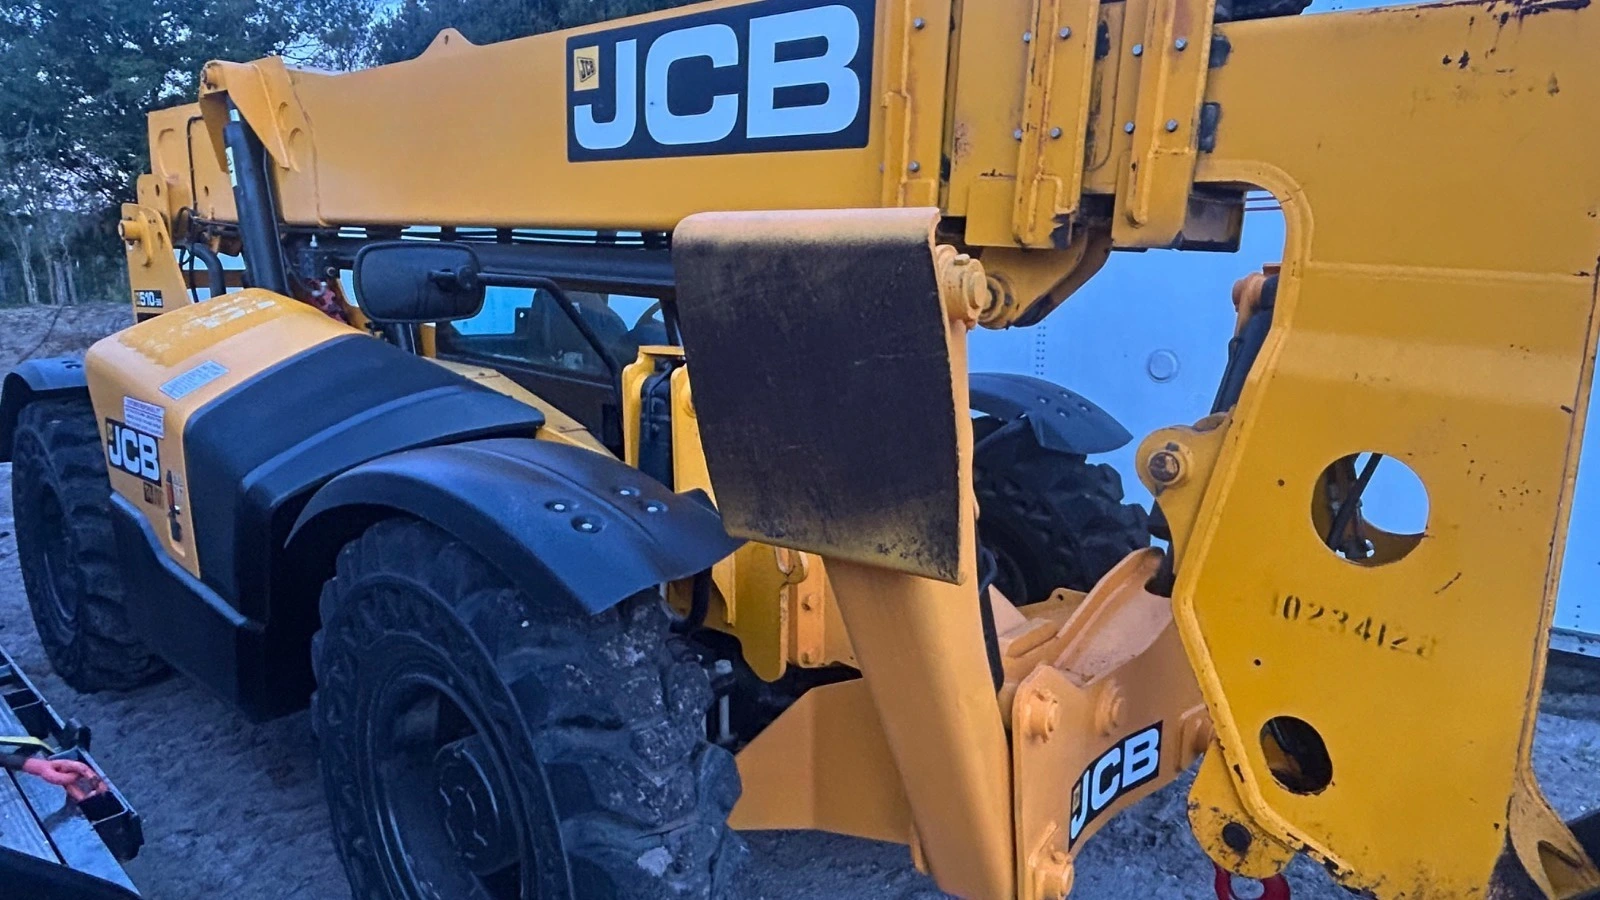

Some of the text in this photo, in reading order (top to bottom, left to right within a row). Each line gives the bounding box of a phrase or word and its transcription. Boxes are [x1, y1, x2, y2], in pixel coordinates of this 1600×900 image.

[573, 4, 861, 150] JCB
[579, 59, 594, 79] JCB
[109, 425, 160, 481] JCB
[1070, 728, 1159, 839] JCB
